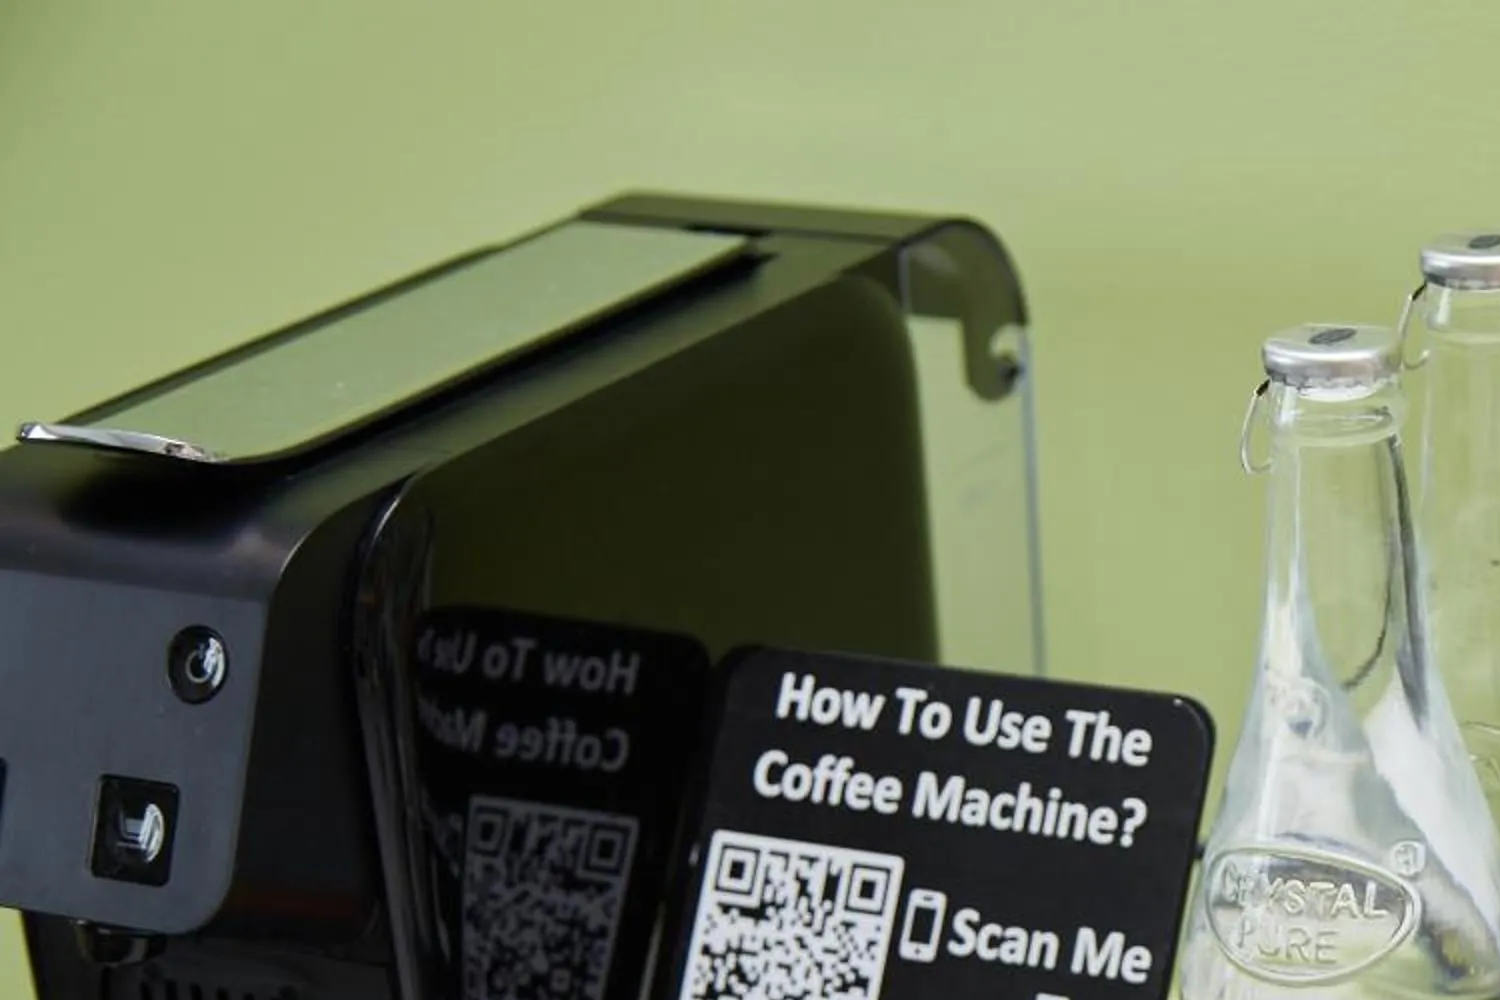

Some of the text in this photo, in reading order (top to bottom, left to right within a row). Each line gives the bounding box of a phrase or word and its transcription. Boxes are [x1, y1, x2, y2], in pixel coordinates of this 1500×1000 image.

[776, 671, 1152, 766] How To Use The
[752, 749, 1147, 848] Coffee Machine?
[948, 908, 1152, 982] Scan Me
